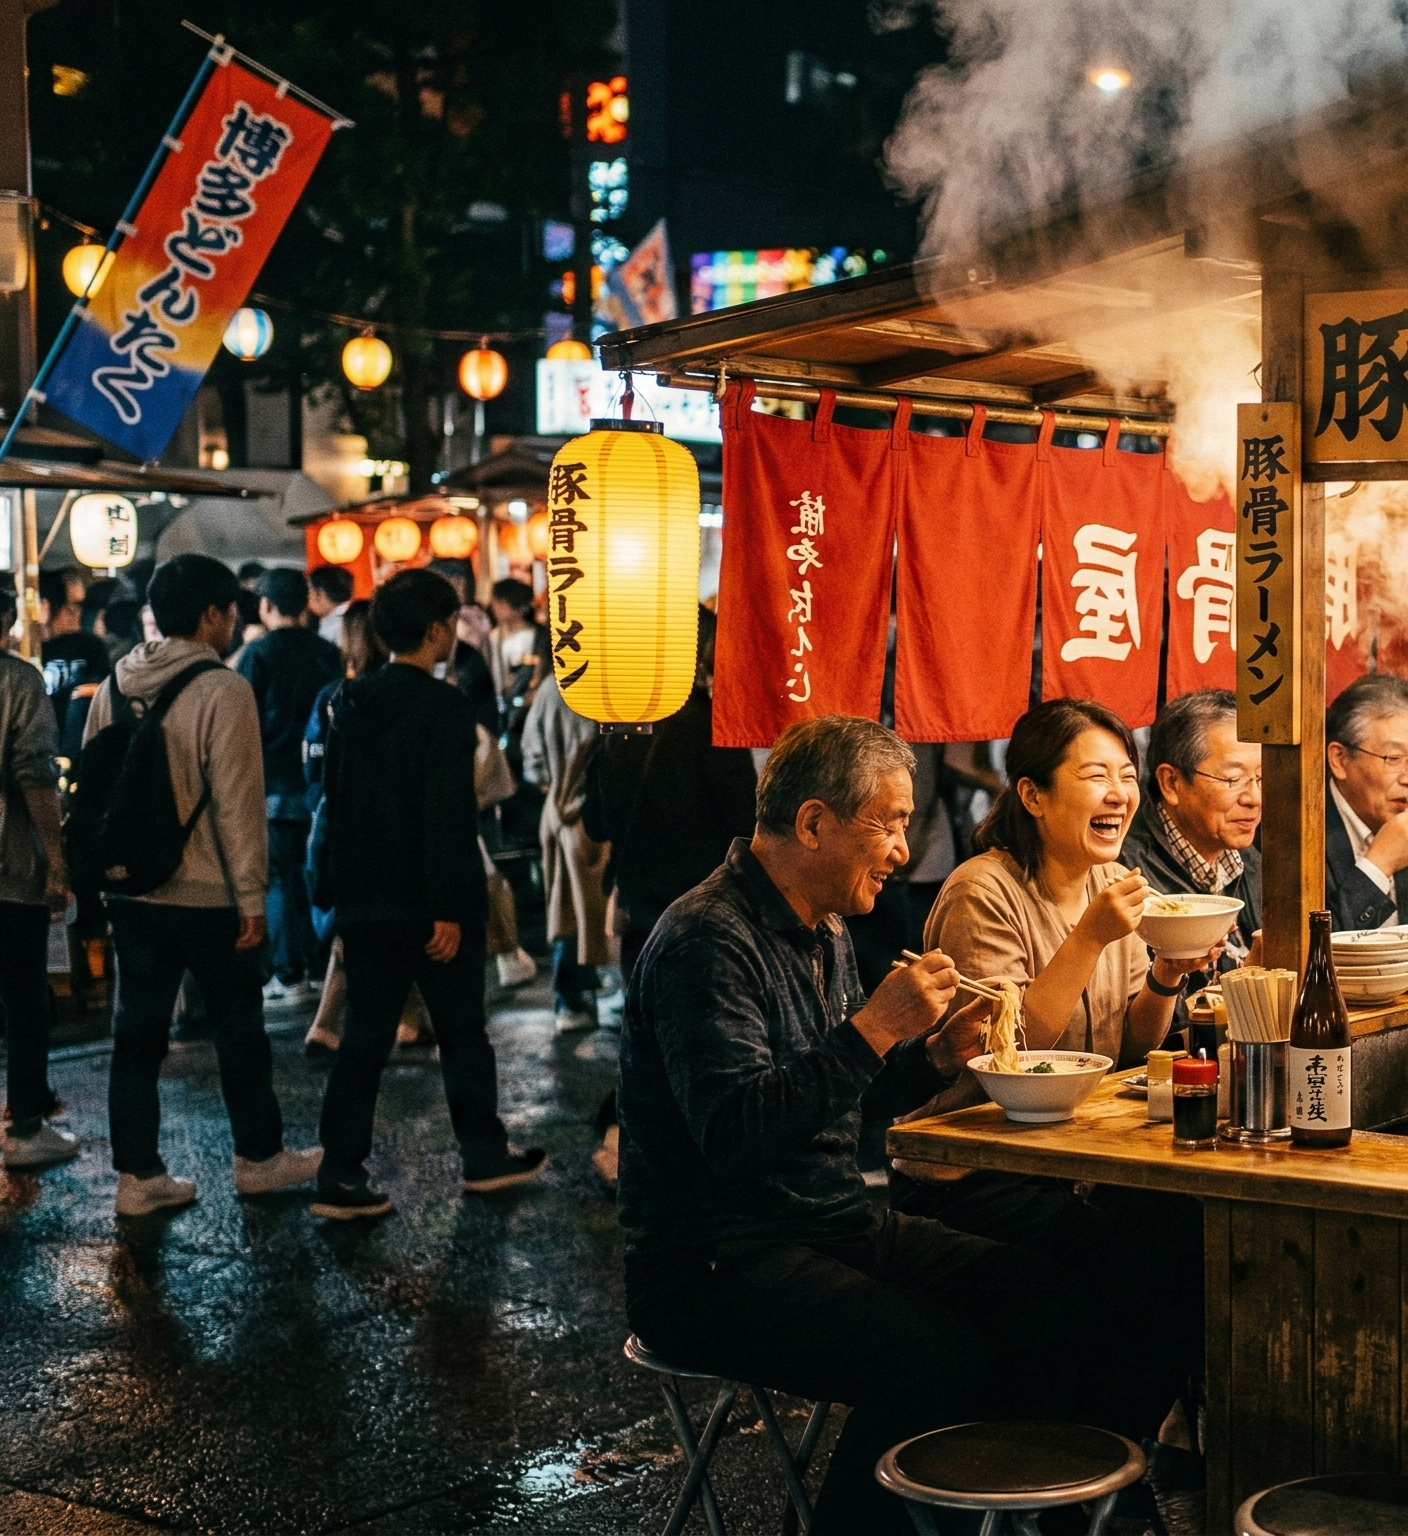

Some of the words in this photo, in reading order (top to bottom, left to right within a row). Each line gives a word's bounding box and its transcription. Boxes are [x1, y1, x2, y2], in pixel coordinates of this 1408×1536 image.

[92, 100, 292, 425] 博多どんたく
[548, 462, 591, 690] 豚骨ラーメン
[1241, 435, 1289, 705] 豚骨ラーメン
